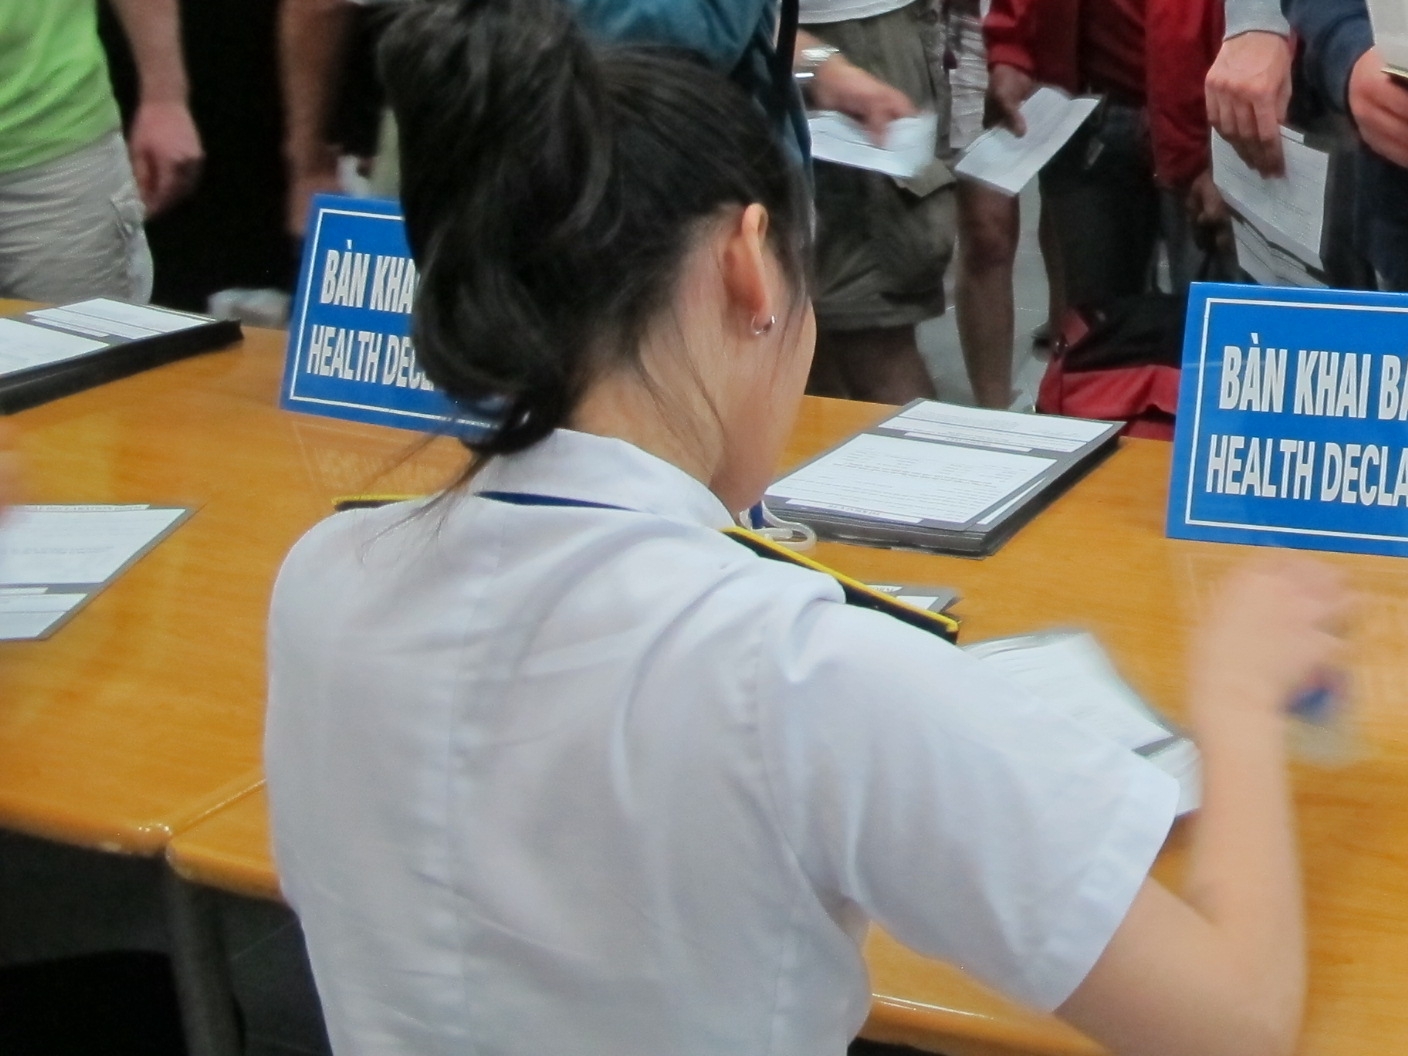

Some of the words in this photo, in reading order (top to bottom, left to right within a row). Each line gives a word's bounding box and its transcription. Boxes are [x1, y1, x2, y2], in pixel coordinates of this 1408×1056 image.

[320, 239, 371, 308] BÀN
[370, 254, 421, 314] KHA
[306, 324, 383, 384] HEALTH
[1218, 332, 1288, 413] BÀN
[1293, 350, 1372, 419] KHAI
[1206, 433, 1316, 501] HEALTH
